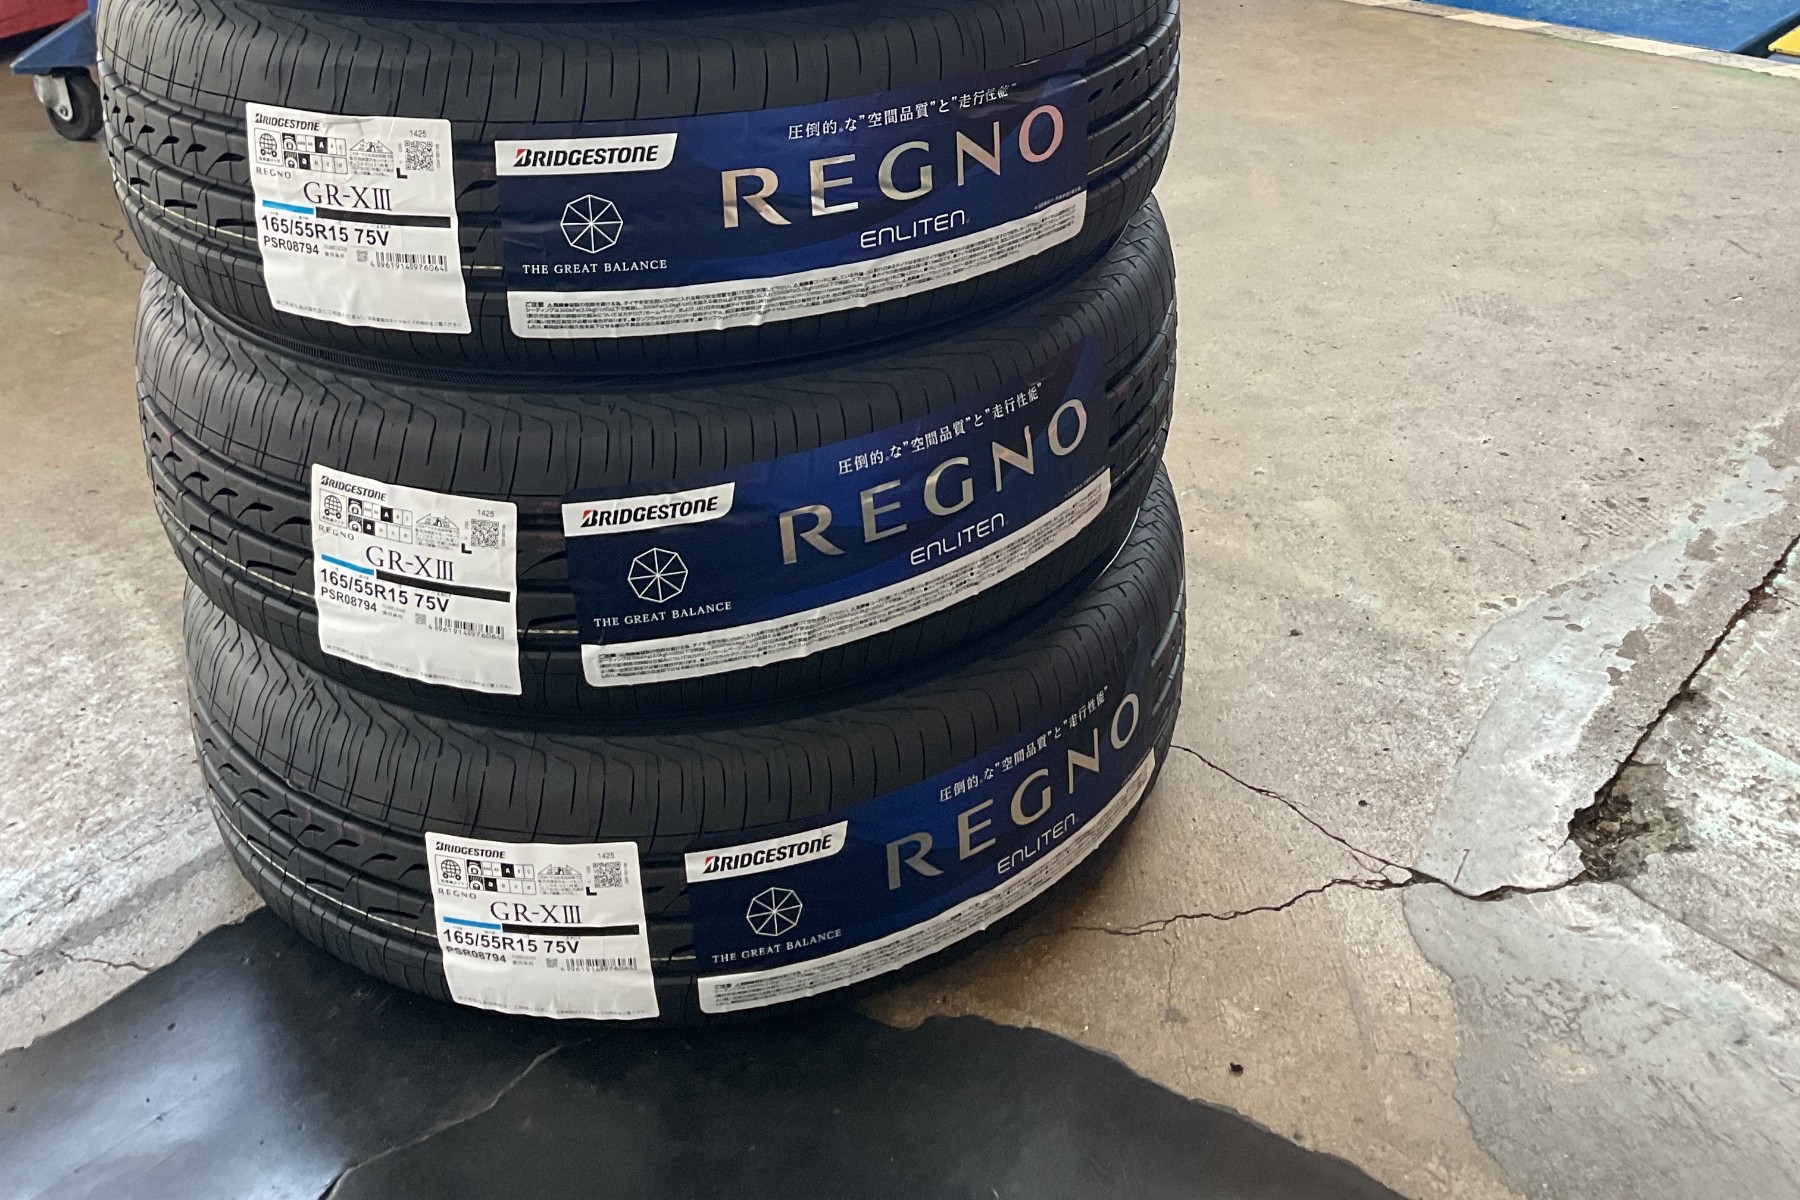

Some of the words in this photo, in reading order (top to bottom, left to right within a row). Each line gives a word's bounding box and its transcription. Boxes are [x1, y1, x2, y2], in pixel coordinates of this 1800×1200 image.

[255, 113, 320, 131] BRIDGESTONE
[409, 130, 427, 138] 1425
[513, 145, 659, 168] BRIDGESTONE
[720, 104, 1064, 228] REGNO
[256, 166, 292, 179] REGNO
[262, 215, 349, 242] 165/55R15
[355, 228, 390, 246] 75V
[860, 209, 966, 249] ENLITEN
[263, 235, 320, 255] PSR08794
[522, 264, 549, 275] THE
[553, 263, 598, 274] GREAT
[603, 259, 668, 273] BALANCE
[321, 475, 387, 501] BRIDGESTONE
[779, 398, 1088, 565] REGNO
[477, 509, 495, 518] 1425
[580, 496, 719, 528] BRIDGESTONE
[318, 525, 355, 541] REGNO
[910, 512, 1006, 566] ENLITEN
[320, 568, 408, 605] 165/55R15
[415, 593, 450, 613] 75V
[321, 587, 377, 612] PSR08794
[594, 617, 620, 628] THE
[624, 611, 667, 625] GREAT
[672, 601, 732, 619] BALANCE
[886, 693, 1140, 891] REGNO
[435, 841, 506, 859] BRIDGESTONE
[597, 852, 615, 860] 1425
[703, 834, 833, 874] BRIDGESTONE
[997, 812, 1075, 875] ENLITEN
[438, 887, 477, 899] REGNO
[443, 929, 538, 952] 165/55R15
[544, 940, 580, 954] 75V
[712, 953, 737, 964] THE
[741, 944, 781, 960] GREAT
[786, 928, 842, 951] BALANCE
[445, 945, 507, 964] PSR08794
